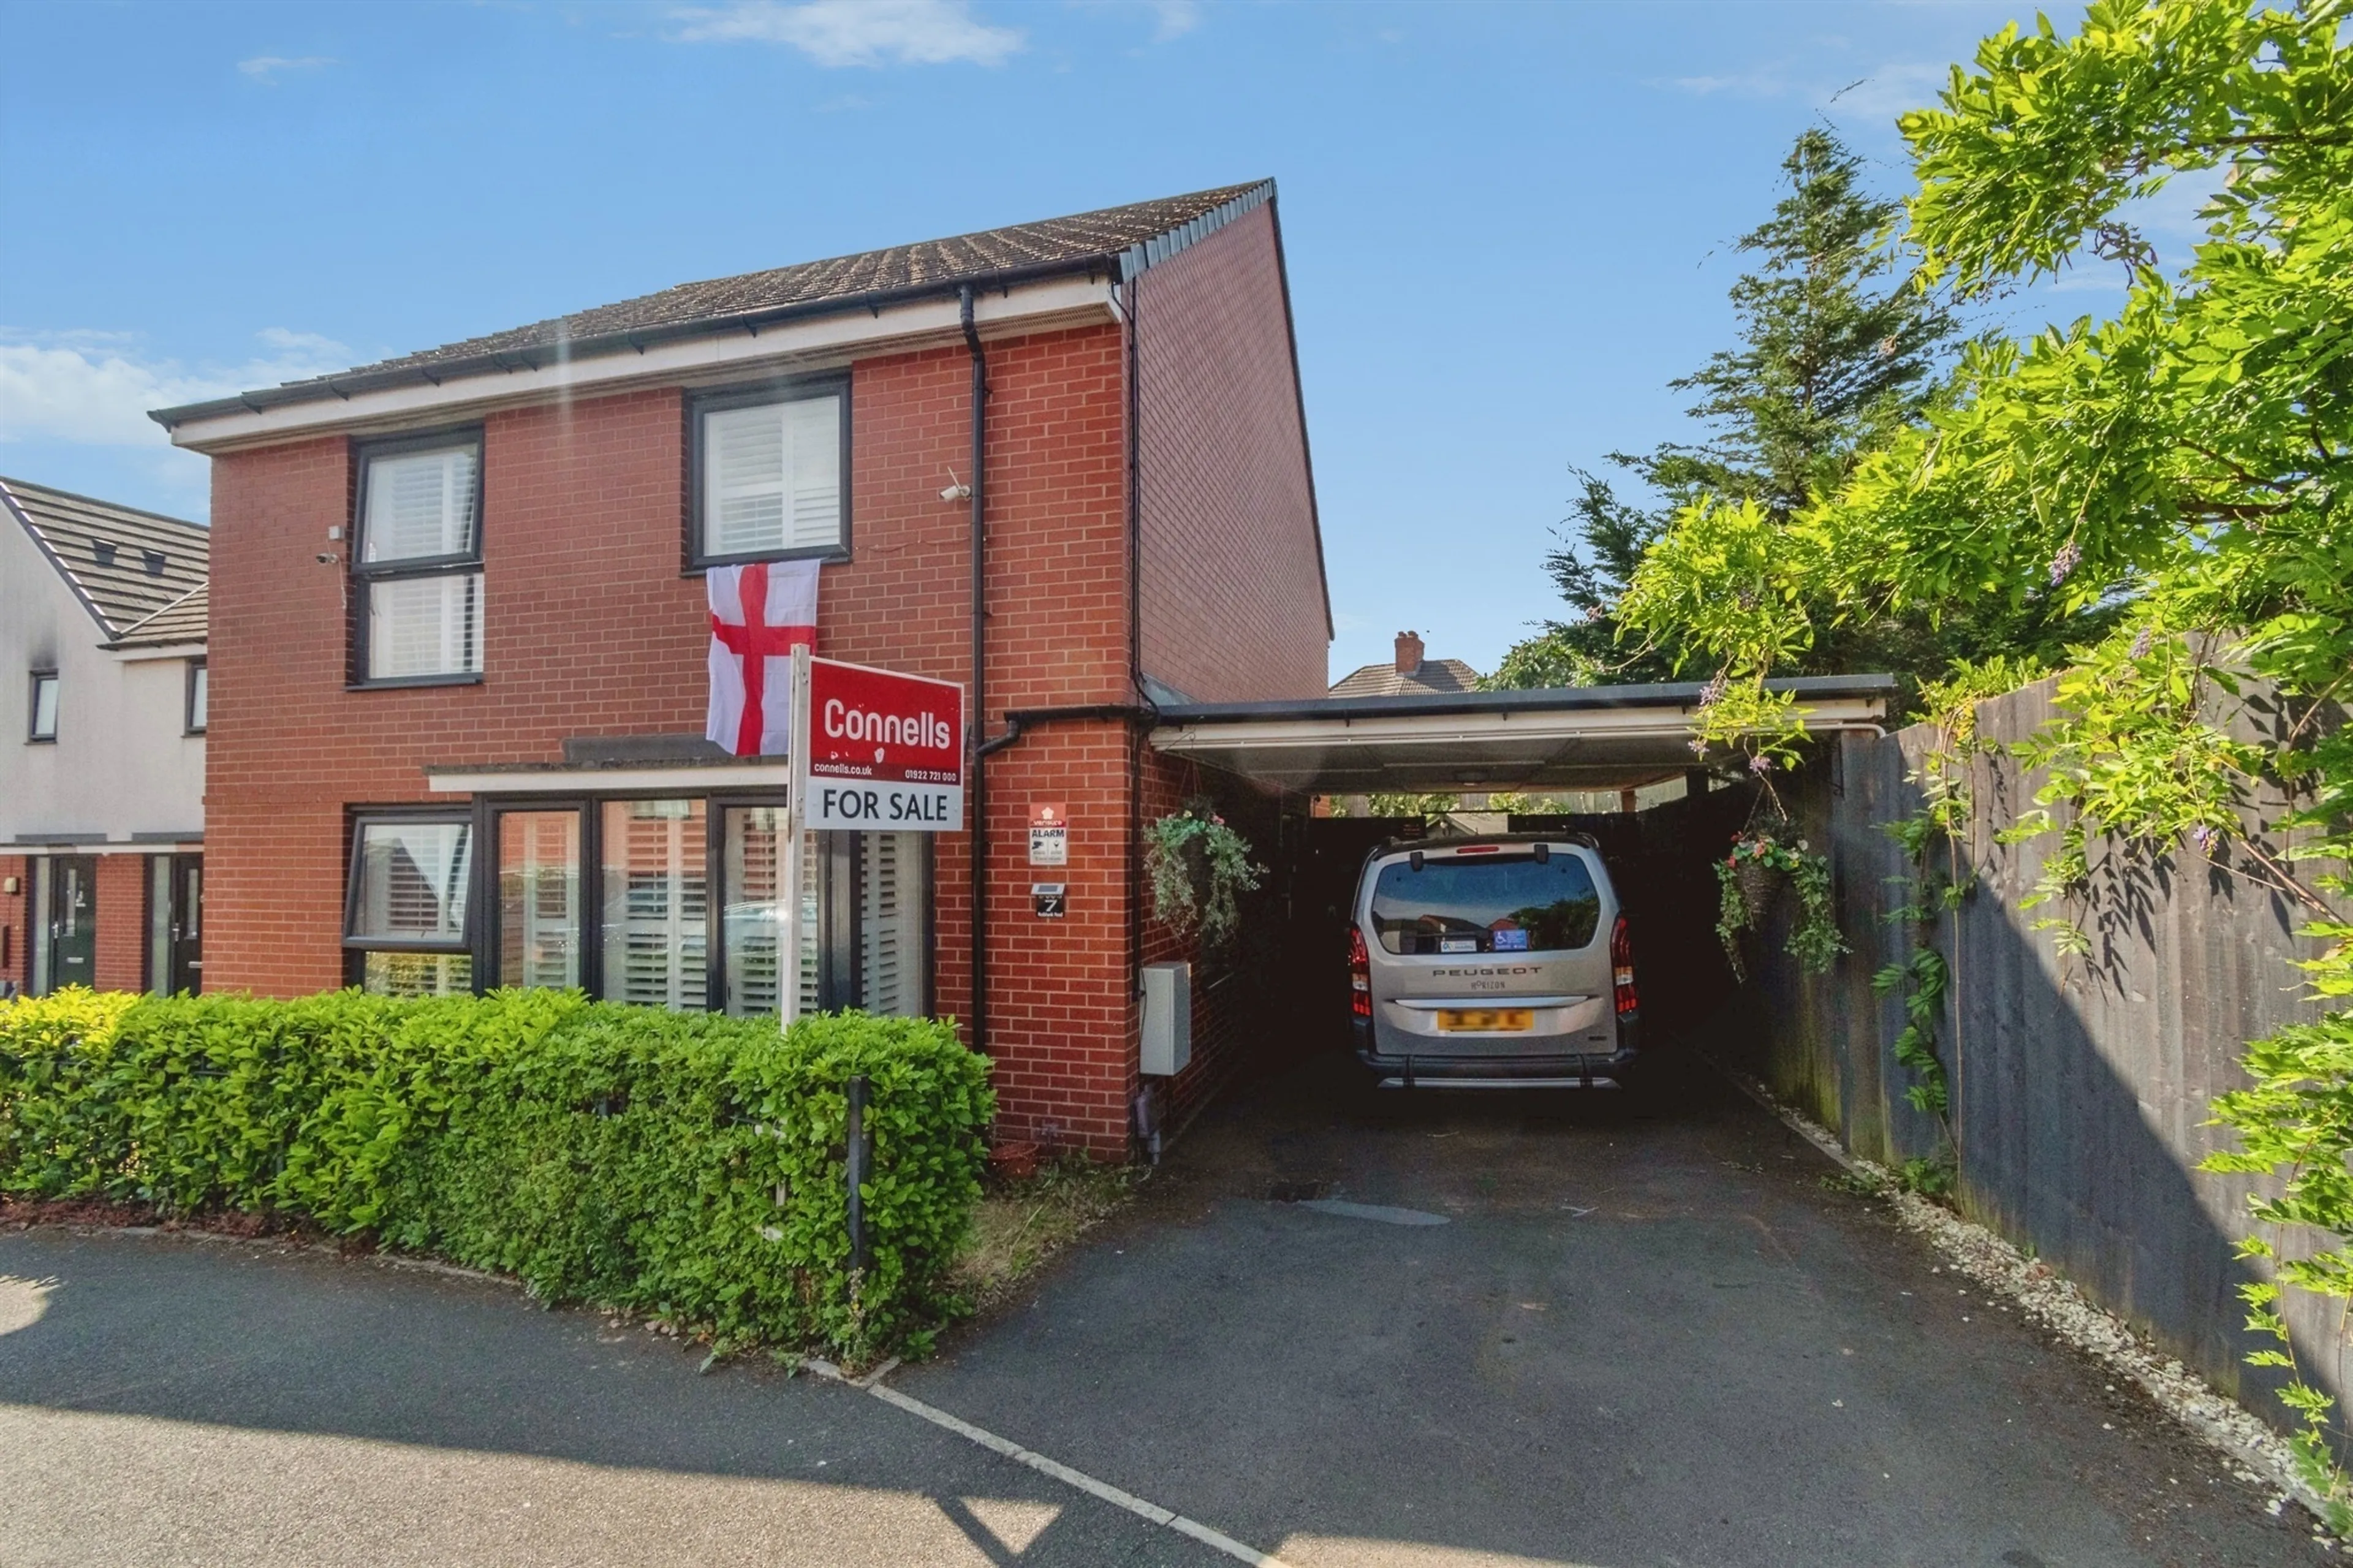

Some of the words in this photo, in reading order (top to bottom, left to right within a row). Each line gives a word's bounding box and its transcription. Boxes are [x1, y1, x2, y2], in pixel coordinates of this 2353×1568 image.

[825, 699, 950, 749] Connells
[814, 763, 872, 776] connells.co.uk
[905, 769, 927, 780] 01922
[930, 771, 941, 781] 721
[942, 772, 957, 782] 000
[823, 789, 881, 820] FOR
[889, 792, 948, 821] SALE
[1032, 829, 1065, 838] ALARM
[1045, 900, 1058, 912] 7
[1433, 967, 1542, 977] PEUGEOT
